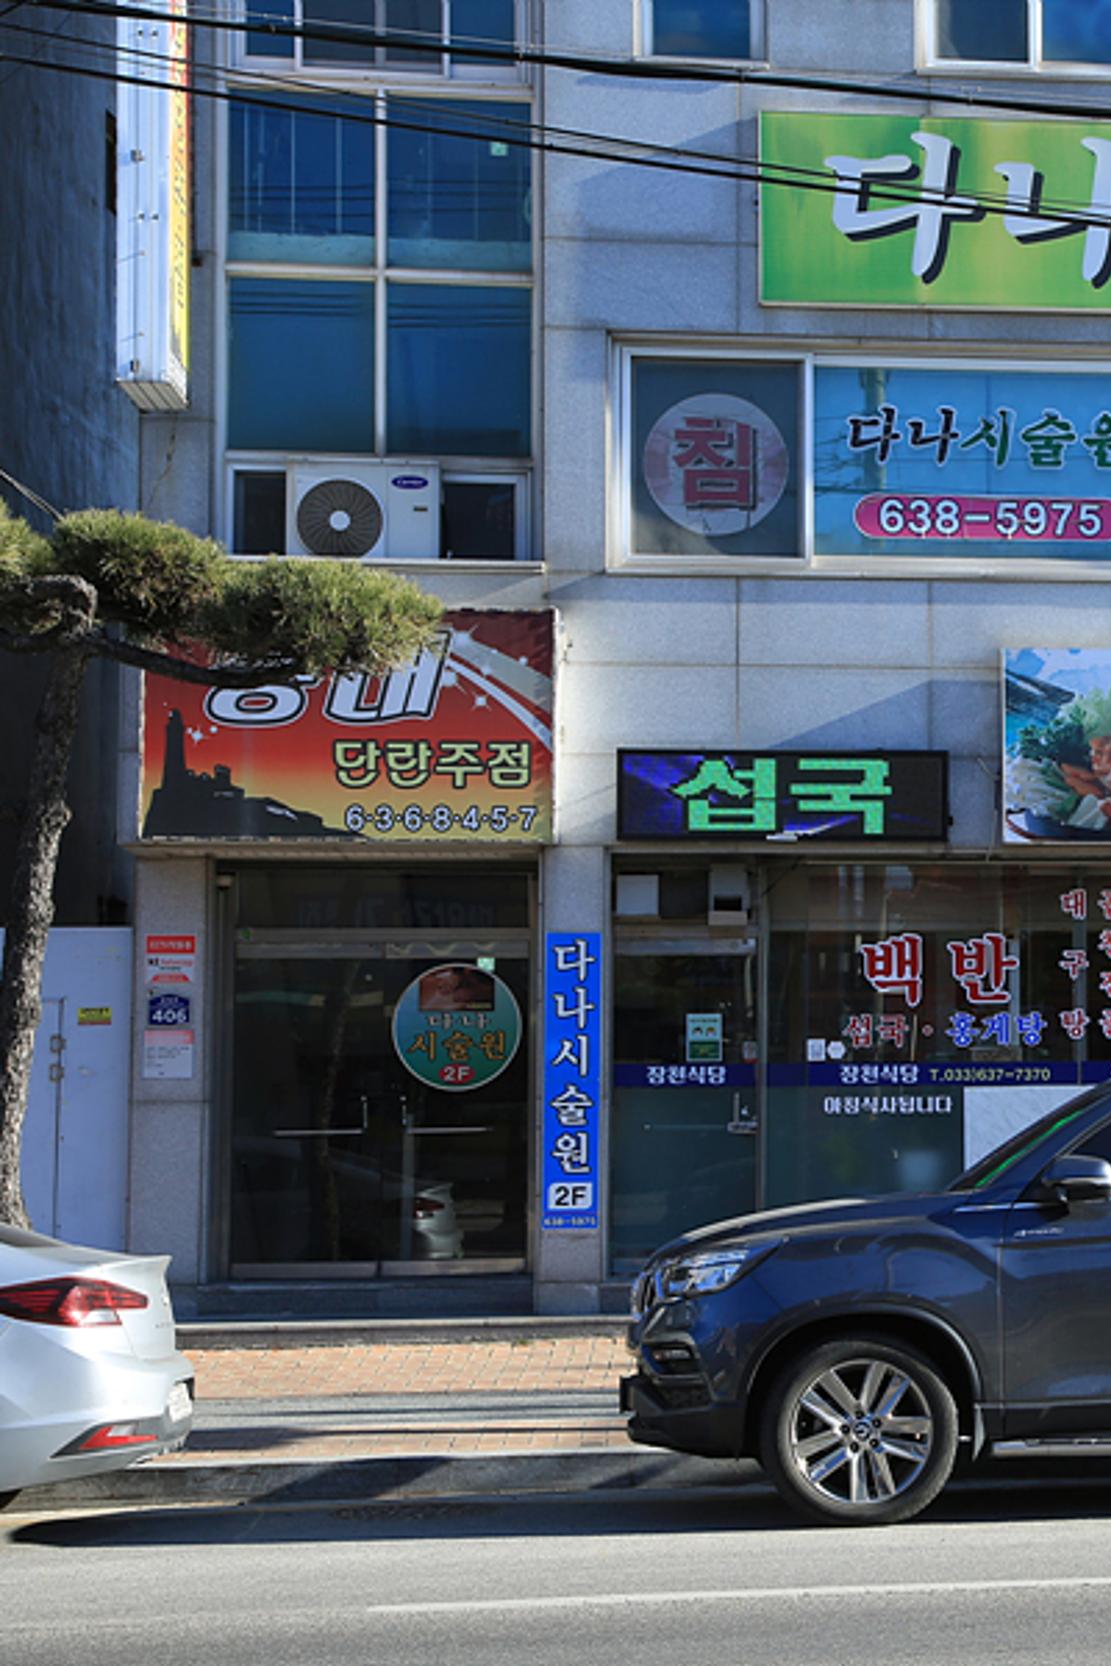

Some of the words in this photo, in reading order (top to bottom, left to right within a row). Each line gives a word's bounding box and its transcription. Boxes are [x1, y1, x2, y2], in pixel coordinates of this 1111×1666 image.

[673, 416, 758, 513] 침
[876, 500, 1104, 537] 638-5975
[333, 739, 533, 789] 단란주점
[669, 757, 894, 835] 섭국
[152, 1008, 187, 1025] 406
[426, 1011, 492, 1031] 다나
[407, 1031, 507, 1062] 시술원
[551, 938, 597, 1175] 다나시술원
[442, 1065, 471, 1082] 2F
[646, 1064, 727, 1085] 장천식당
[839, 1064, 920, 1085] 장천식당
[554, 1185, 588, 1207] 2F
